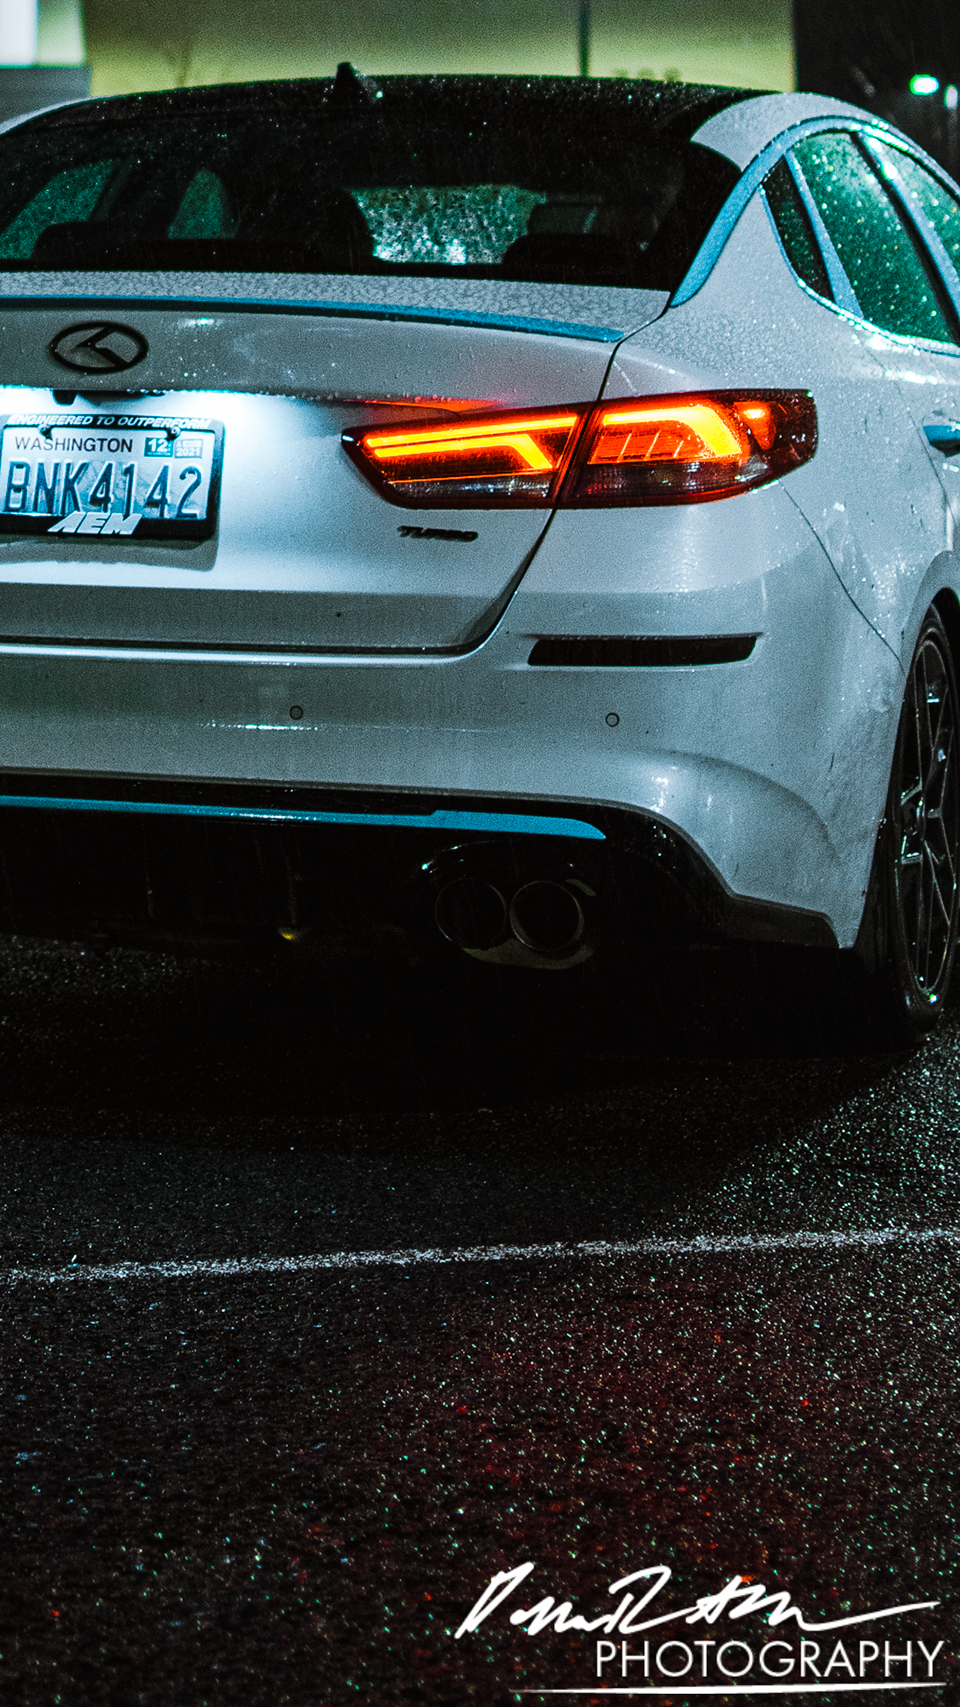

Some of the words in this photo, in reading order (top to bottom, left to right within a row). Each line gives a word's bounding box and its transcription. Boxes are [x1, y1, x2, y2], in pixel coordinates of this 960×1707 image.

[7, 413, 92, 426] ENGINEERED
[96, 415, 115, 426] TO
[119, 416, 212, 430] OUTPERFORM
[14, 436, 133, 453] WASHINGTON
[148, 438, 169, 453] 12
[175, 447, 201, 457] 2021
[4, 460, 203, 519] BNK4142
[48, 511, 142, 535] AEM
